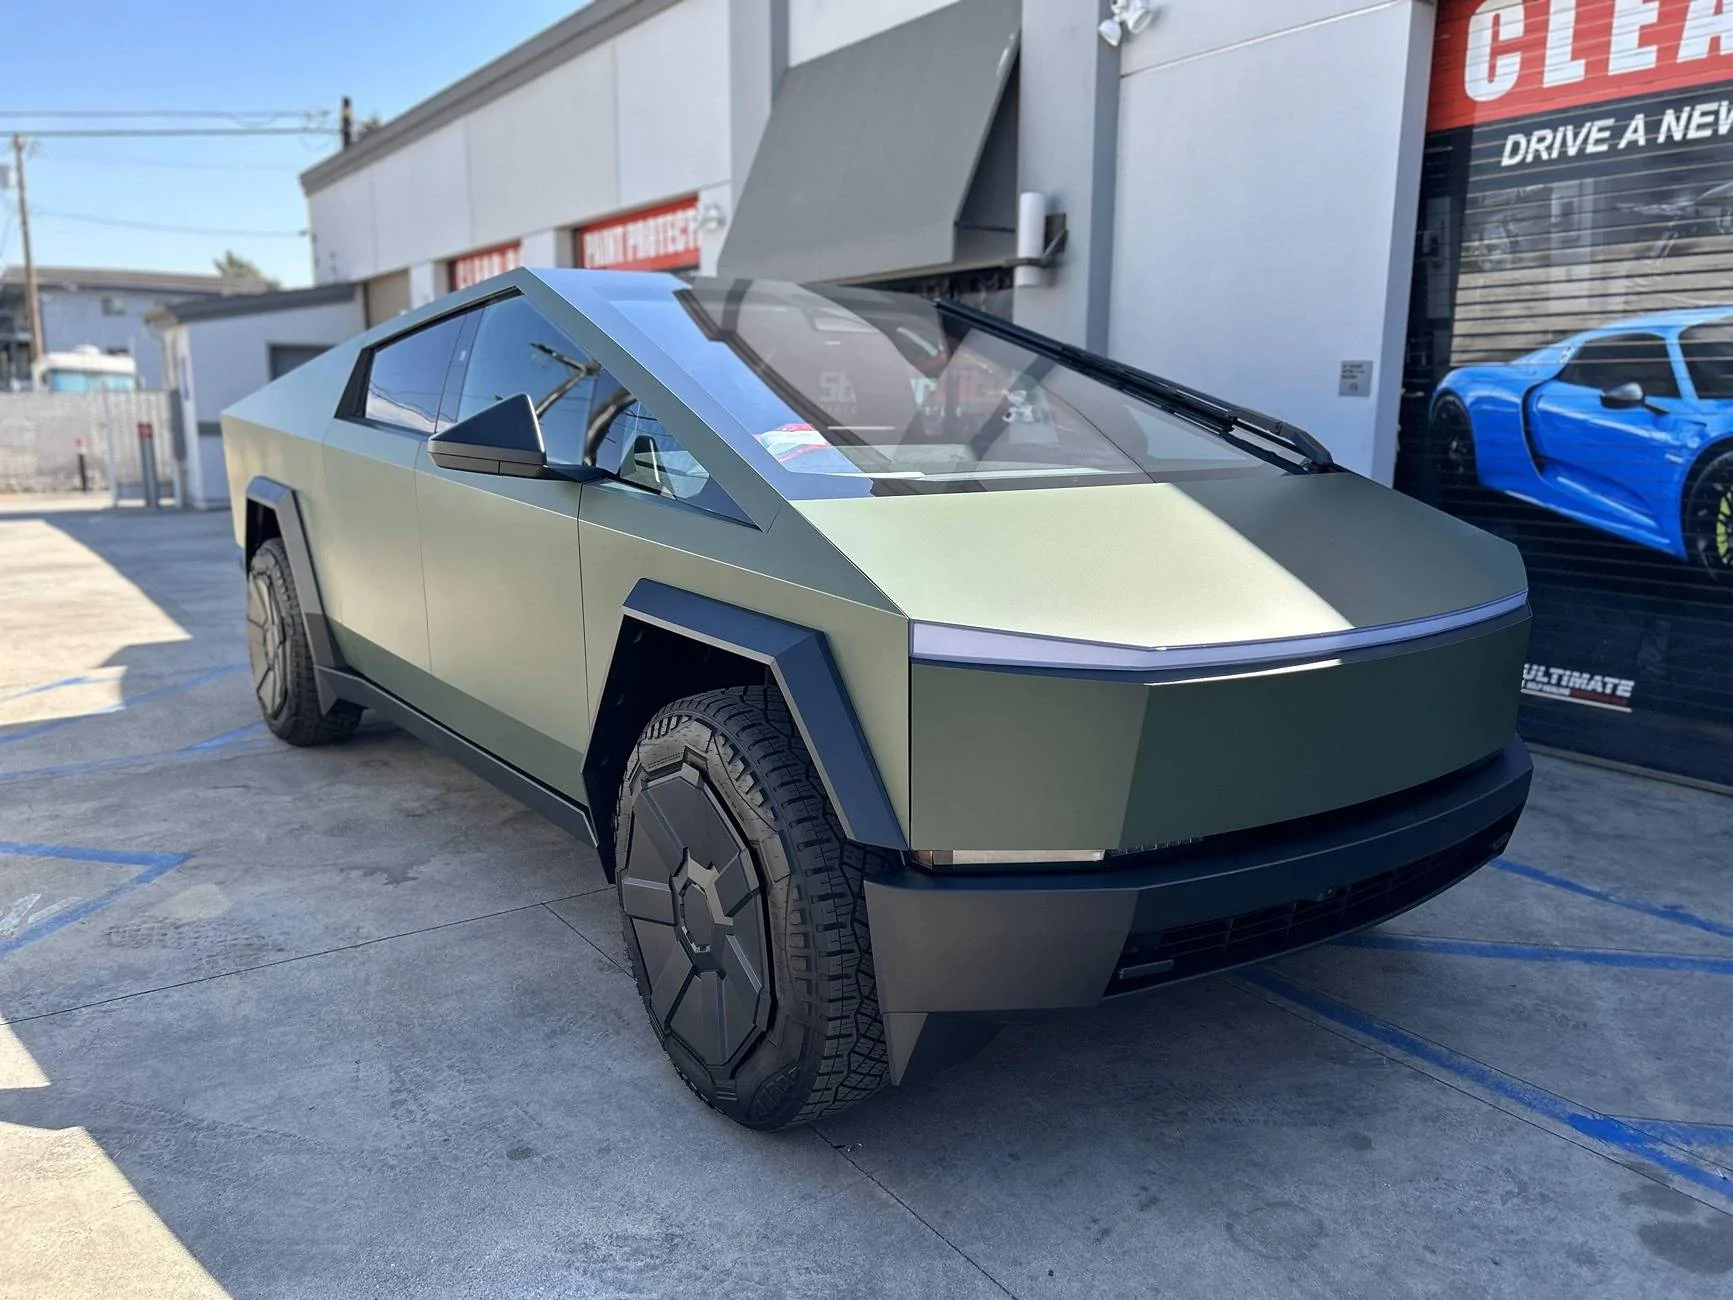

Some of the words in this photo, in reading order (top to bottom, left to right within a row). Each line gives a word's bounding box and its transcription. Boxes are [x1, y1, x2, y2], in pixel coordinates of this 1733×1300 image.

[1501, 117, 1616, 167] DRIVE
[1618, 113, 1646, 149] A
[1523, 663, 1635, 698] ULTIMATE
